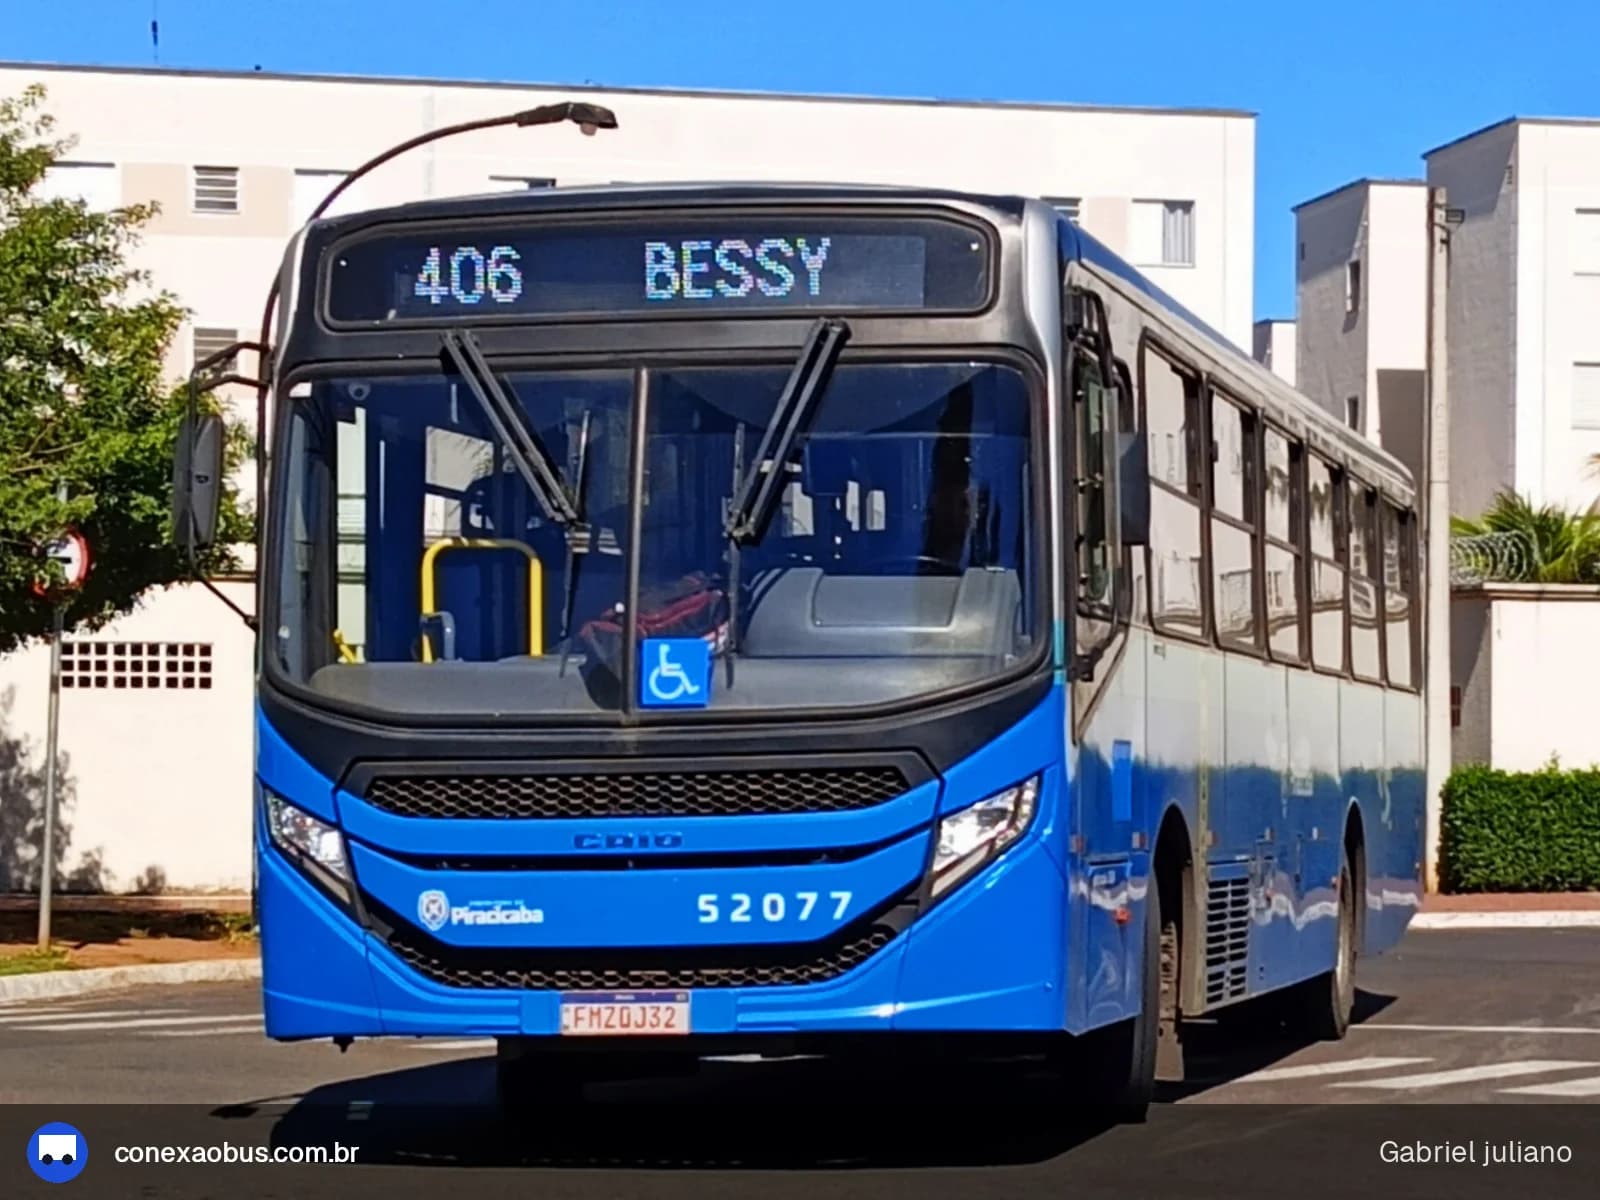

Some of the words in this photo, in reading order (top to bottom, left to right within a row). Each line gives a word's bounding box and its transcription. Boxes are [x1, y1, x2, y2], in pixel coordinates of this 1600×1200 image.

[414, 245, 522, 304] 406
[645, 237, 832, 300] BESSY
[573, 832, 683, 849] CAIO
[697, 890, 853, 923] 52077
